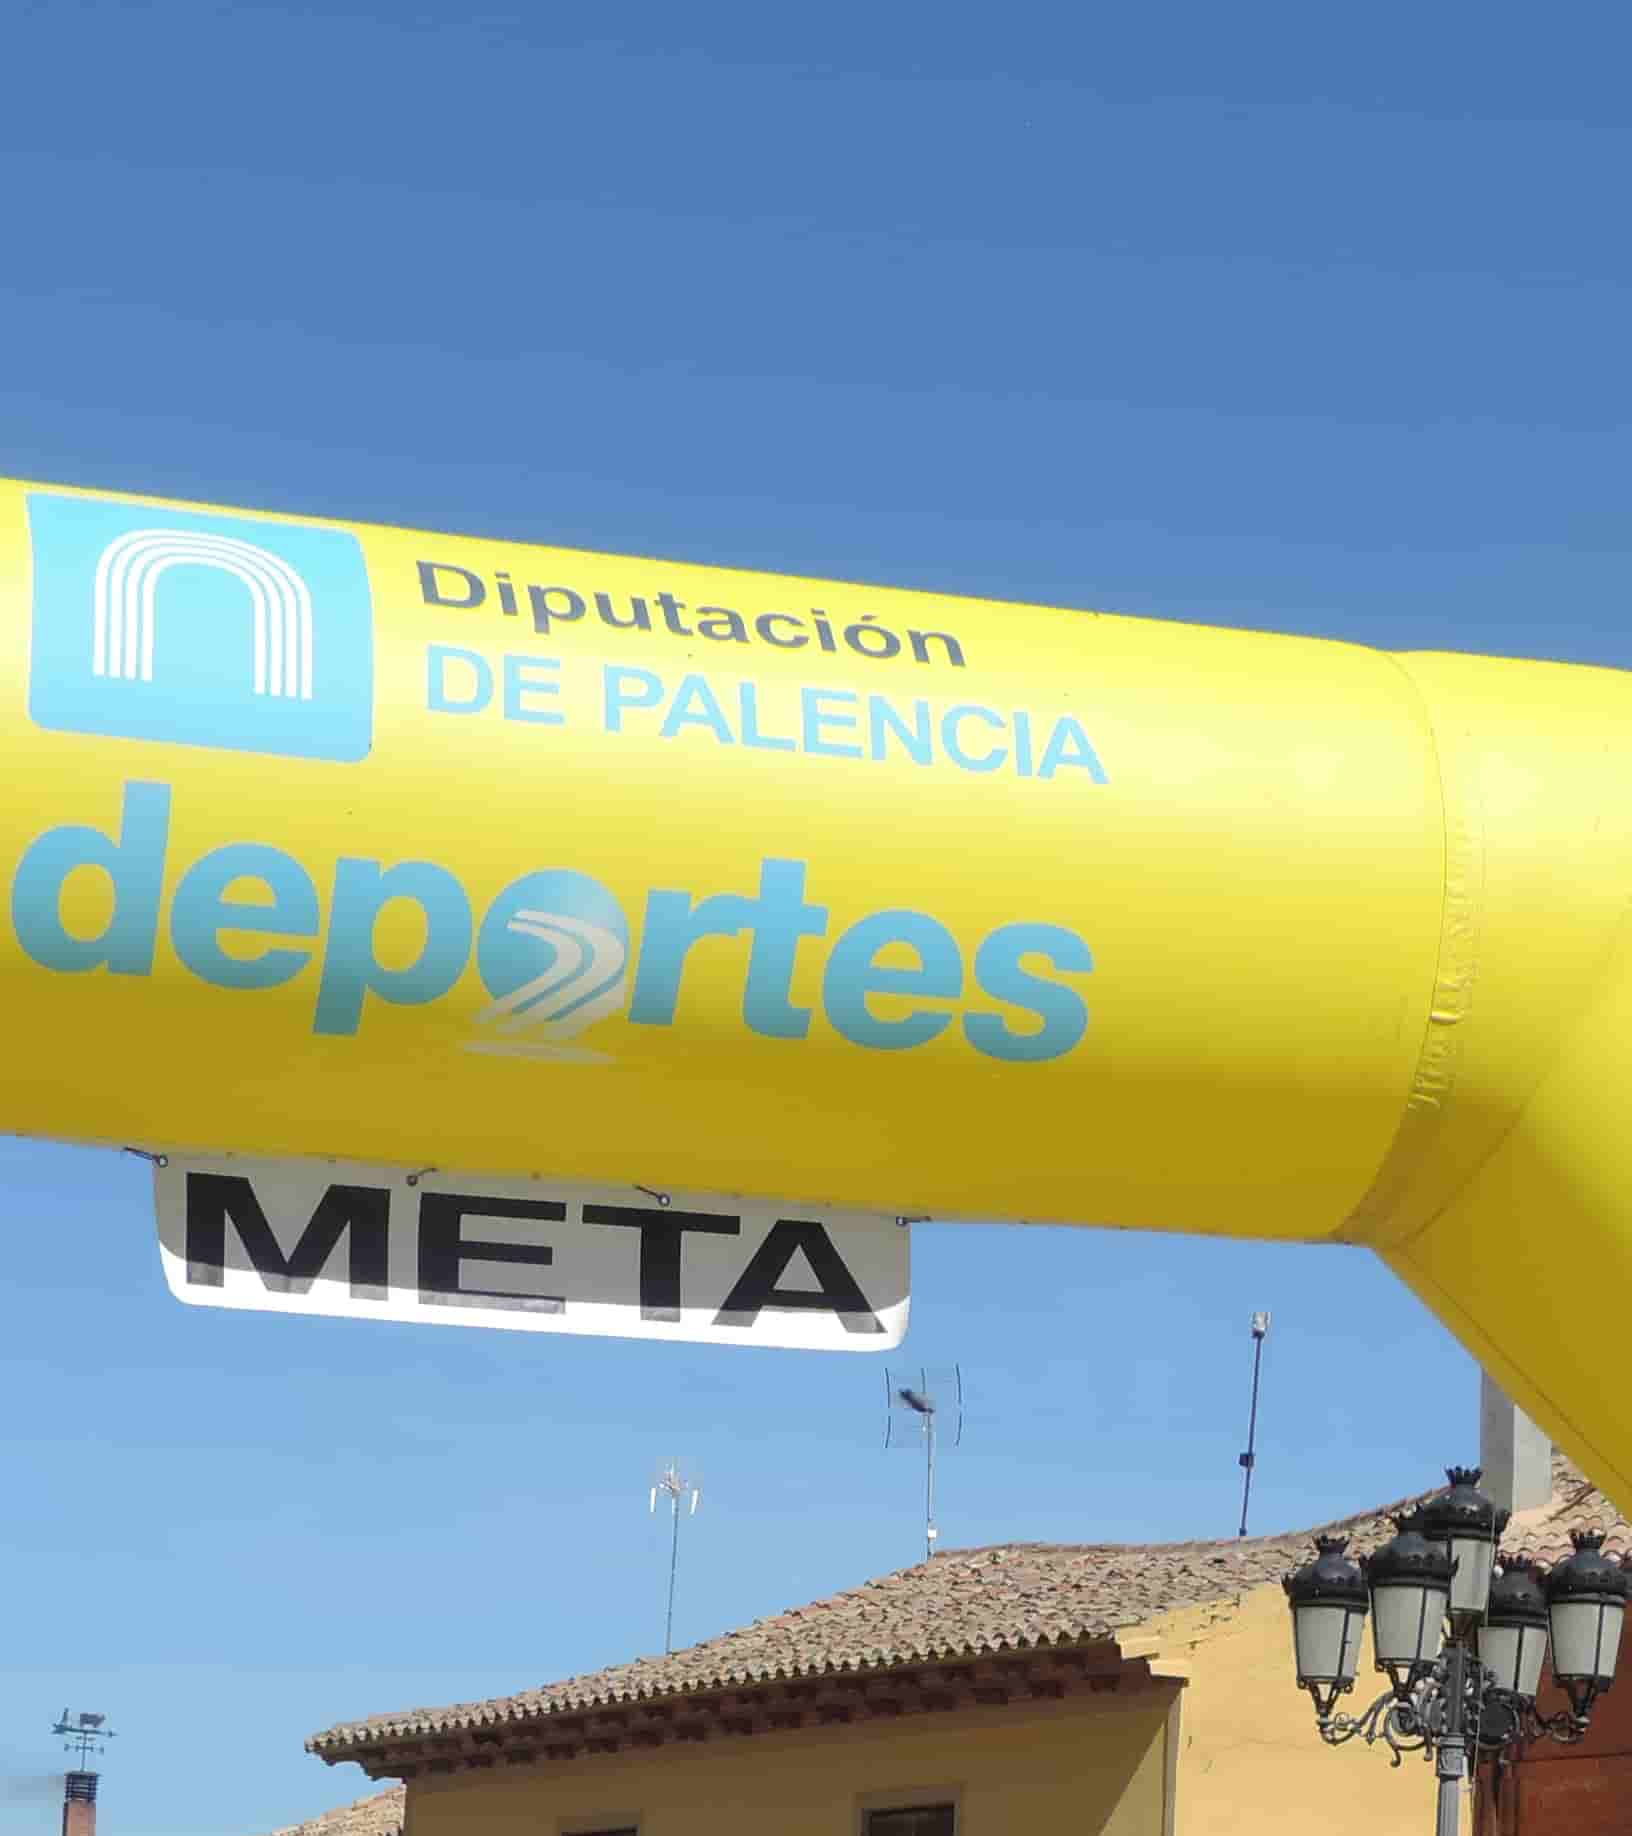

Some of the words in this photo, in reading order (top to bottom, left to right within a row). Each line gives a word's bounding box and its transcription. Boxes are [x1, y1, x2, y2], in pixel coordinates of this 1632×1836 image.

[415, 558, 968, 668] Diputación
[424, 642, 566, 727] DE
[601, 662, 1111, 786] PALENCIA
[11, 779, 1095, 1065] deportes
[184, 1172, 888, 1335] META
